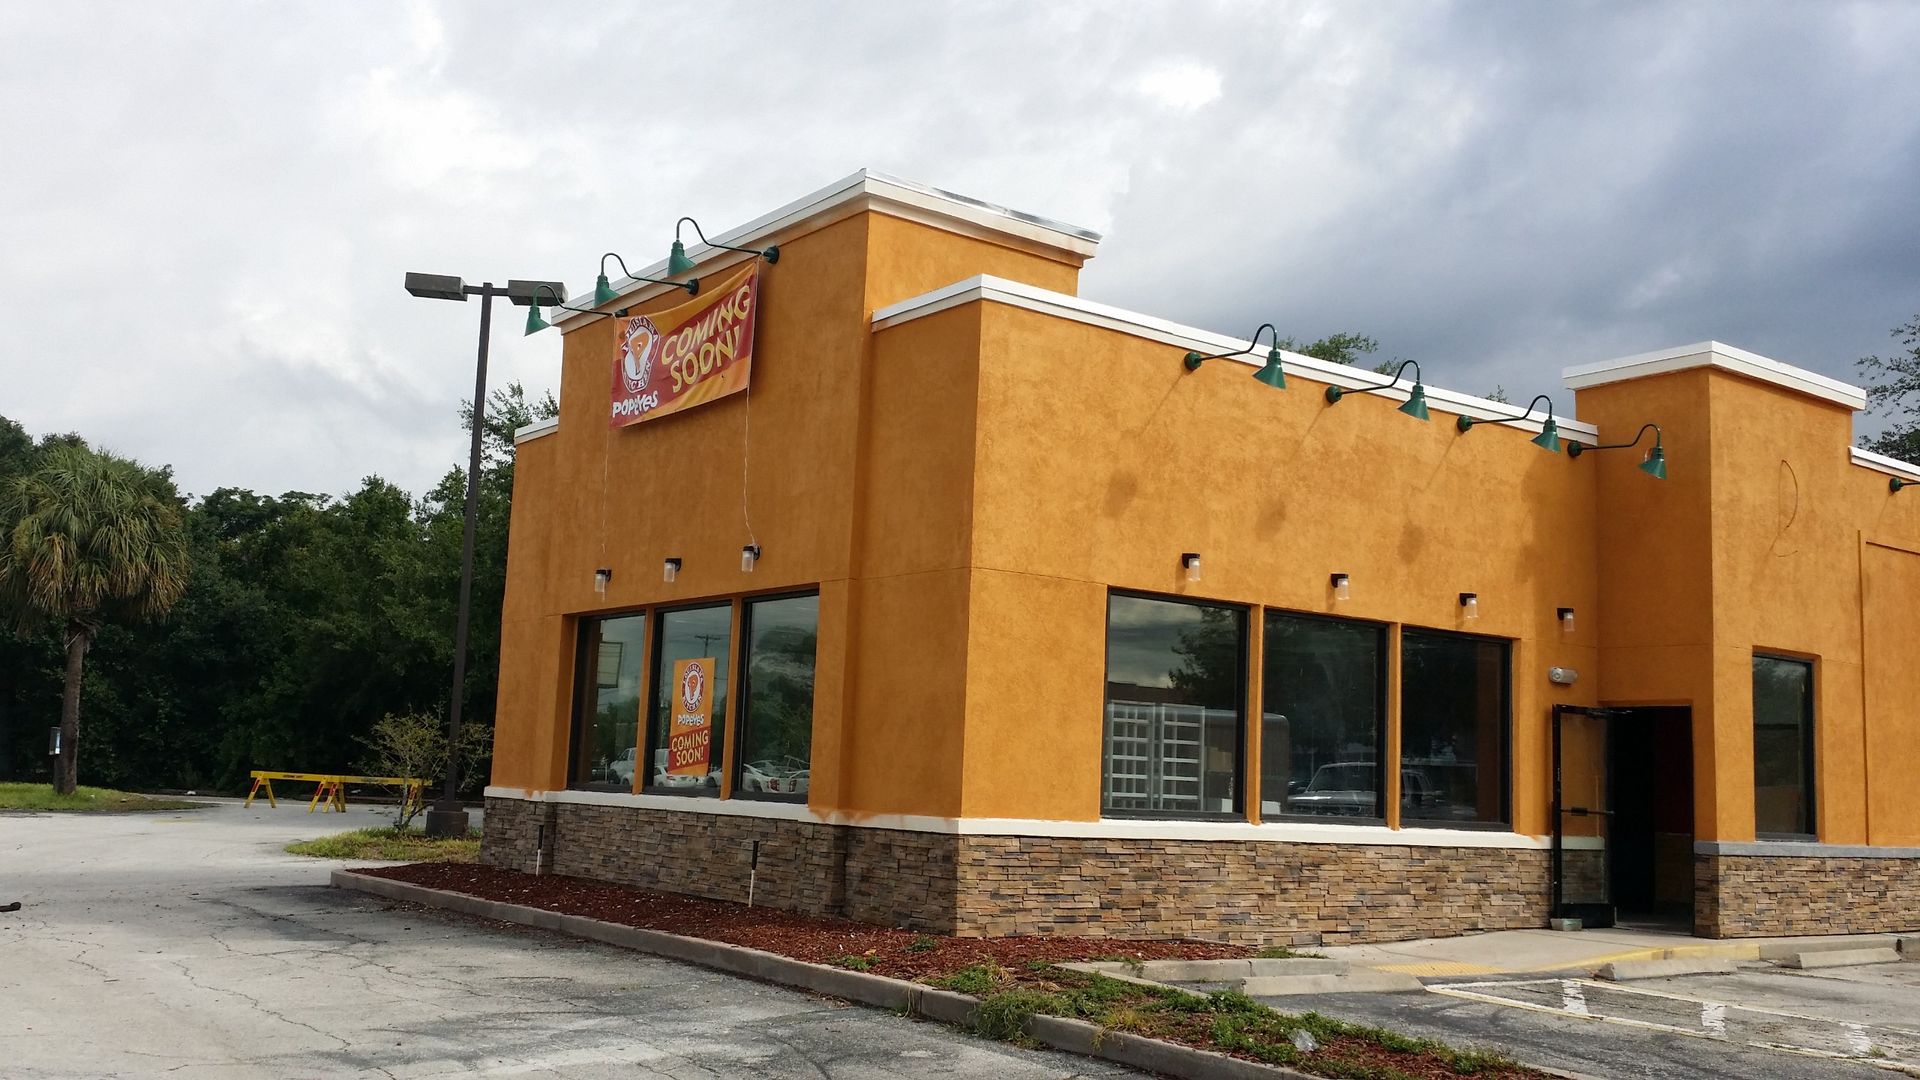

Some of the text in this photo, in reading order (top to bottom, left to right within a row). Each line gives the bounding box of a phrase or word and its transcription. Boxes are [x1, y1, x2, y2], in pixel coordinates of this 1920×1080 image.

[661, 285, 751, 365] COMING
[670, 325, 740, 393] SOON!
[671, 730, 709, 752] COMING
[676, 748, 704, 767] SOON!
